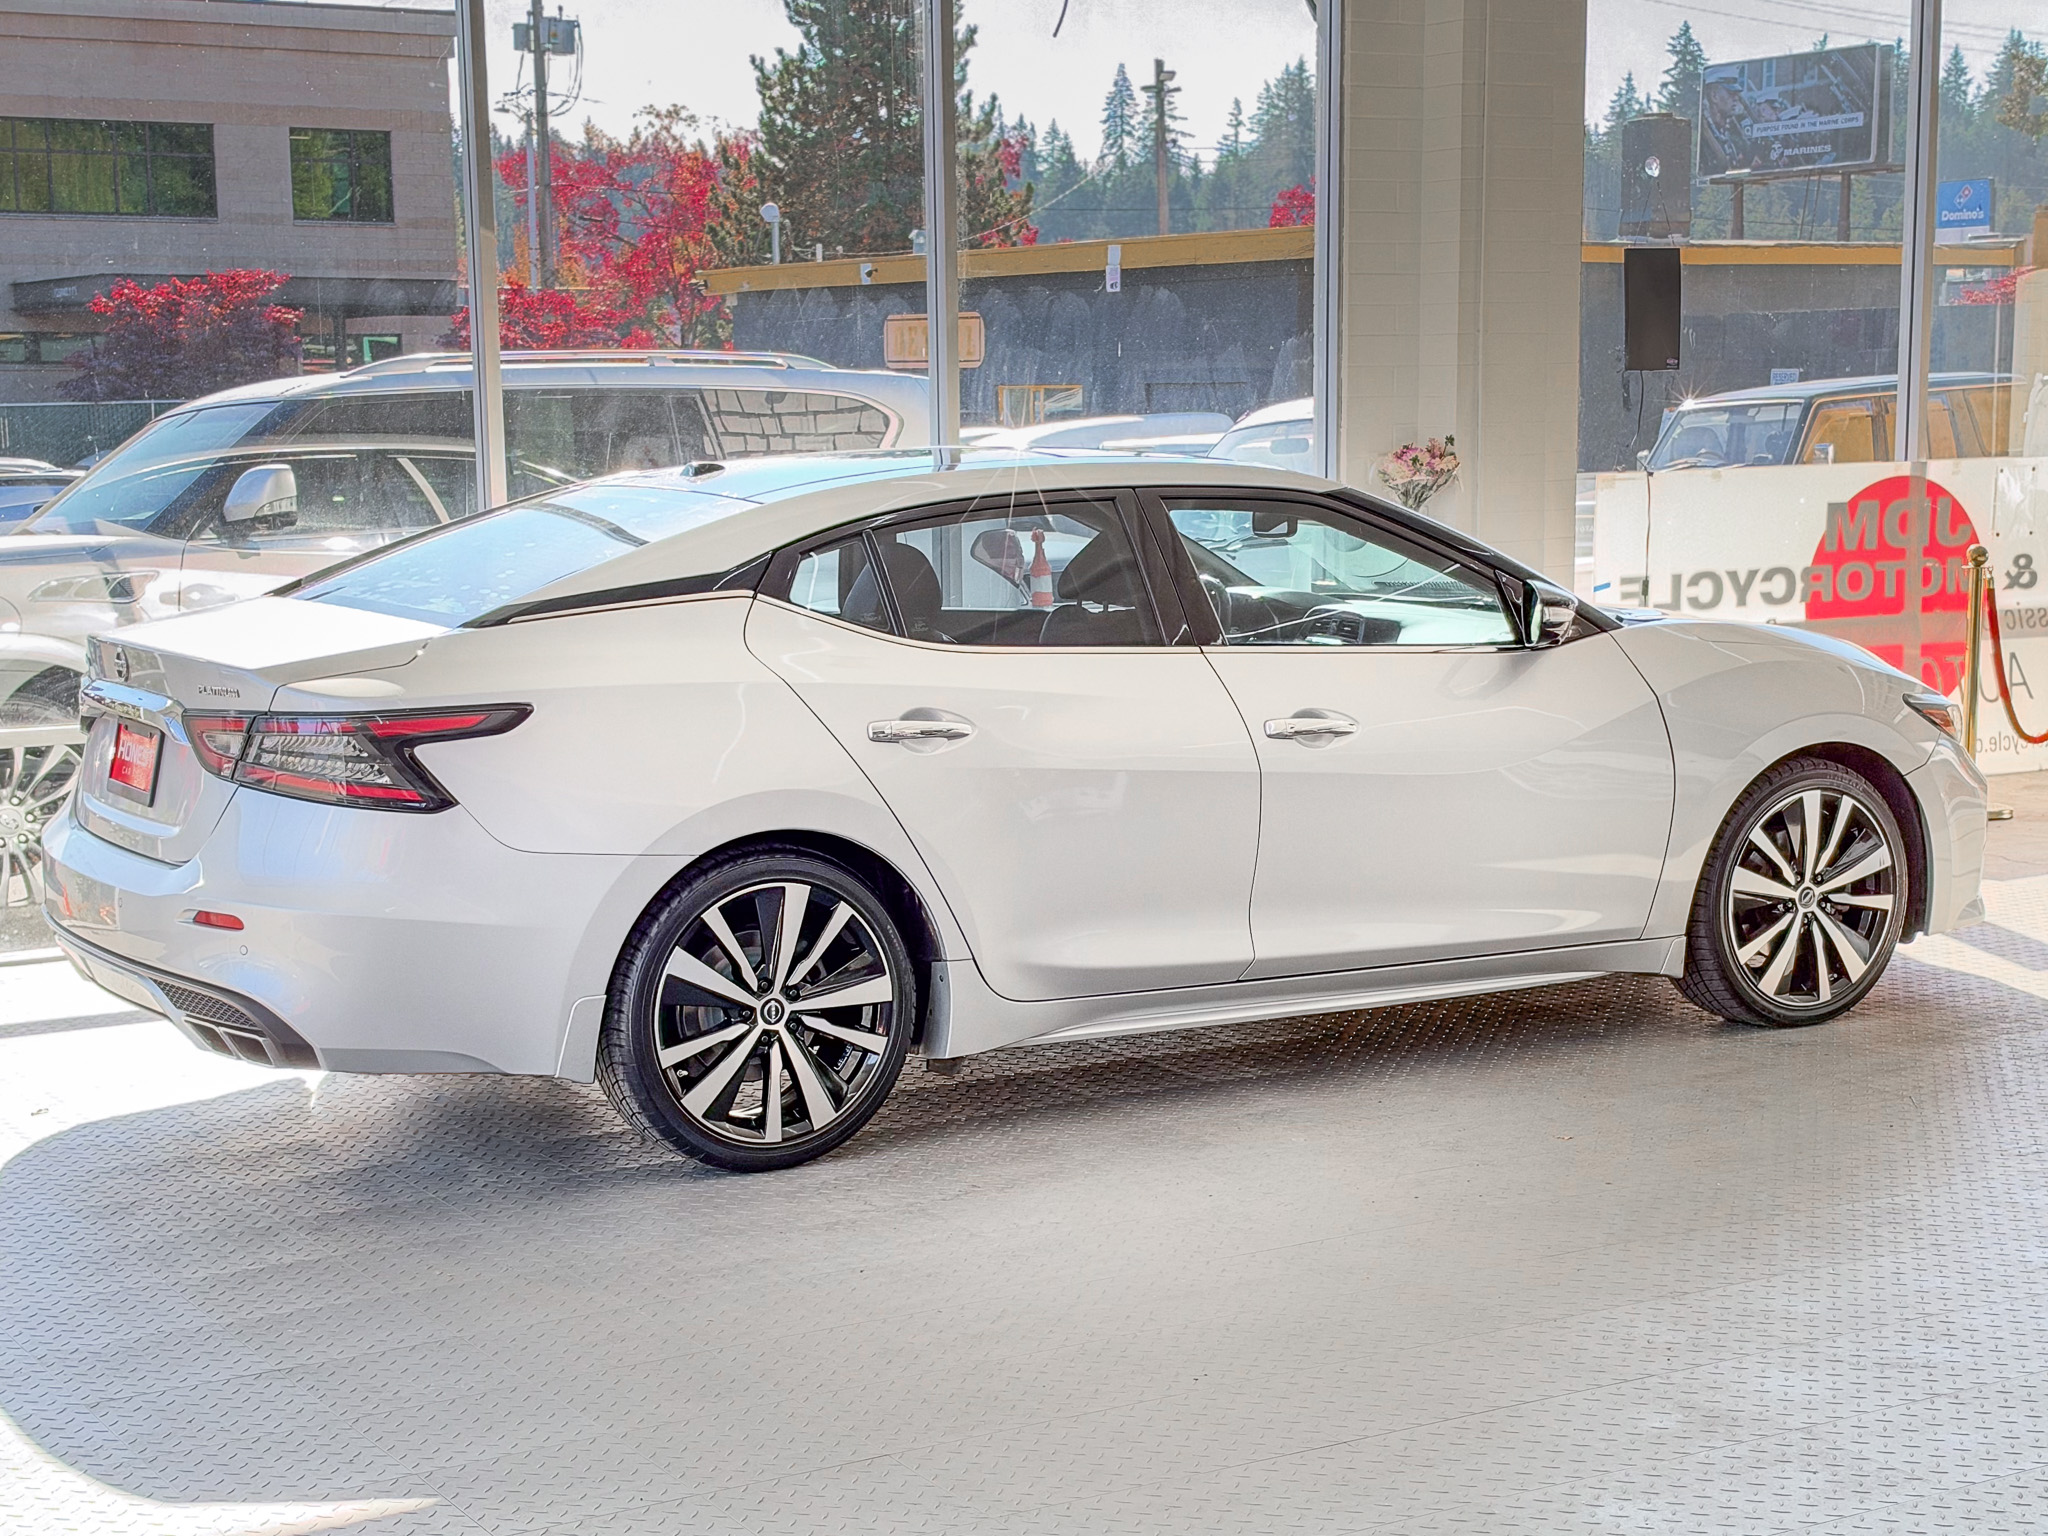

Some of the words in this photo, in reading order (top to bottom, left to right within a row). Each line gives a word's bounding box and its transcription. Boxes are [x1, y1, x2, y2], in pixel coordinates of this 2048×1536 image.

[1756, 124, 1780, 133] PURPOSE
[1781, 122, 1799, 131] FOUND
[1808, 120, 1817, 128] THE
[1819, 118, 1839, 126] MARINE
[1841, 116, 1859, 125] CORPS
[1783, 144, 1832, 157] MARINES
[1941, 208, 1985, 221] Domino's
[198, 684, 241, 699] PLATINUM
